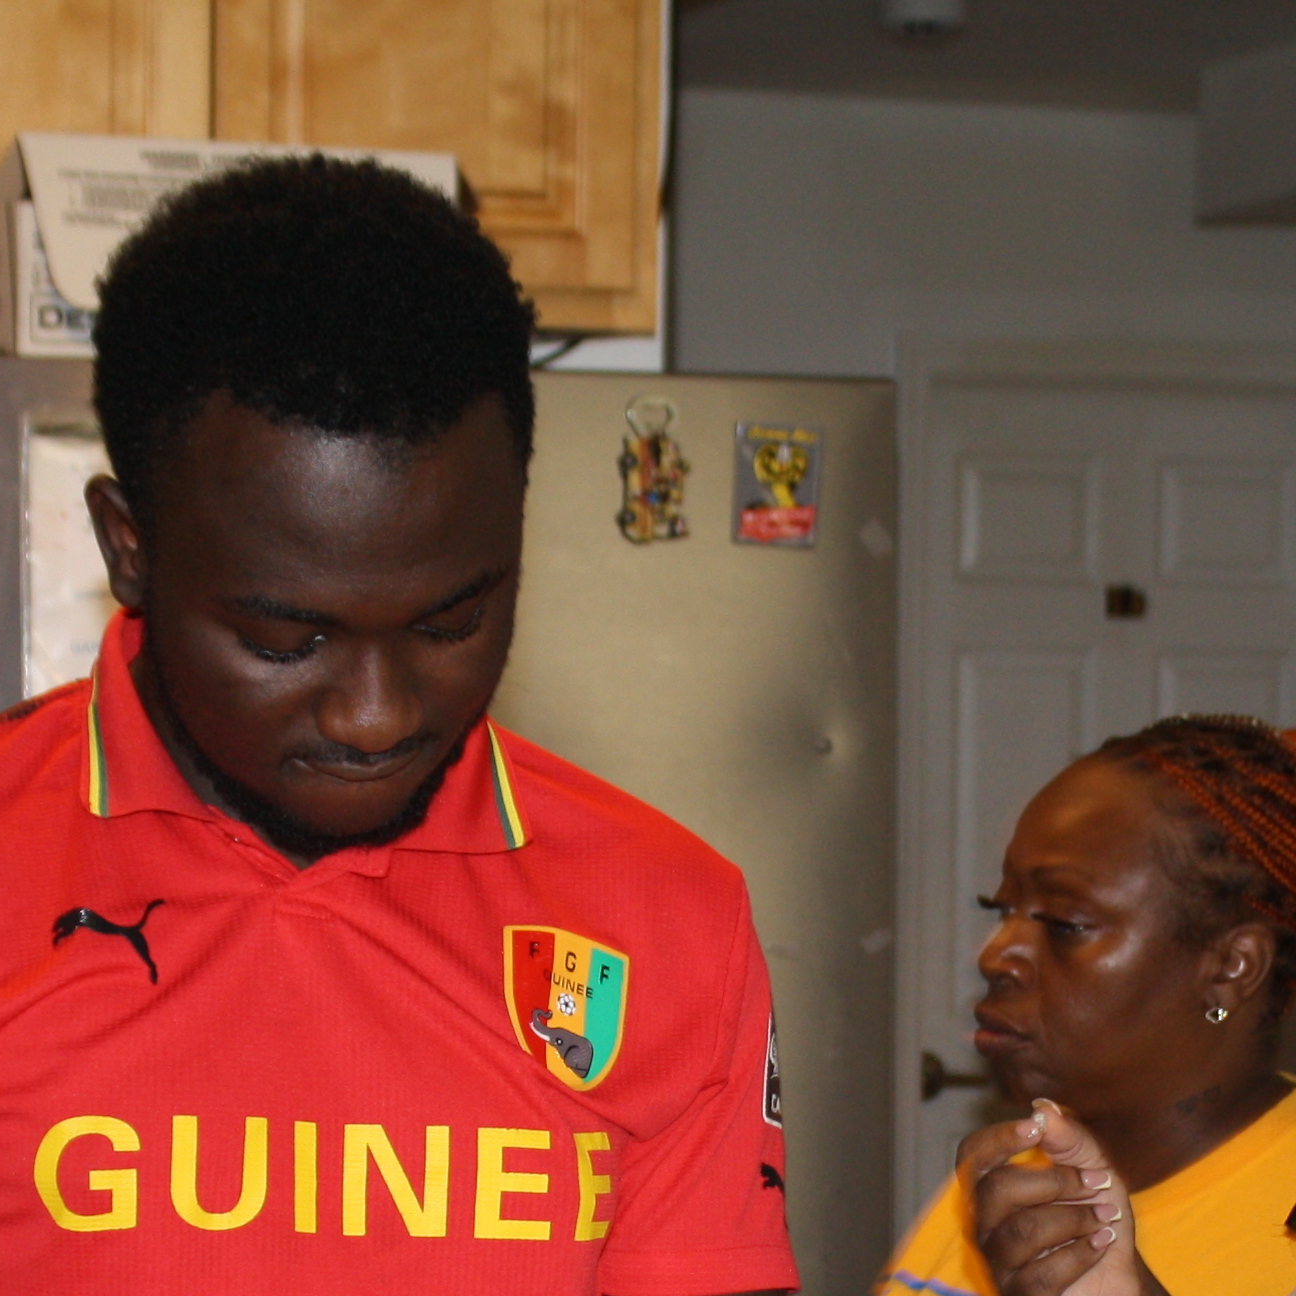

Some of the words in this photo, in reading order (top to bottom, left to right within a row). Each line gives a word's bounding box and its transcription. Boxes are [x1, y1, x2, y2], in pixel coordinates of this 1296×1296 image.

[565, 950, 577, 973] G
[599, 964, 611, 985] F
[33, 1114, 612, 1242] GUINEE
